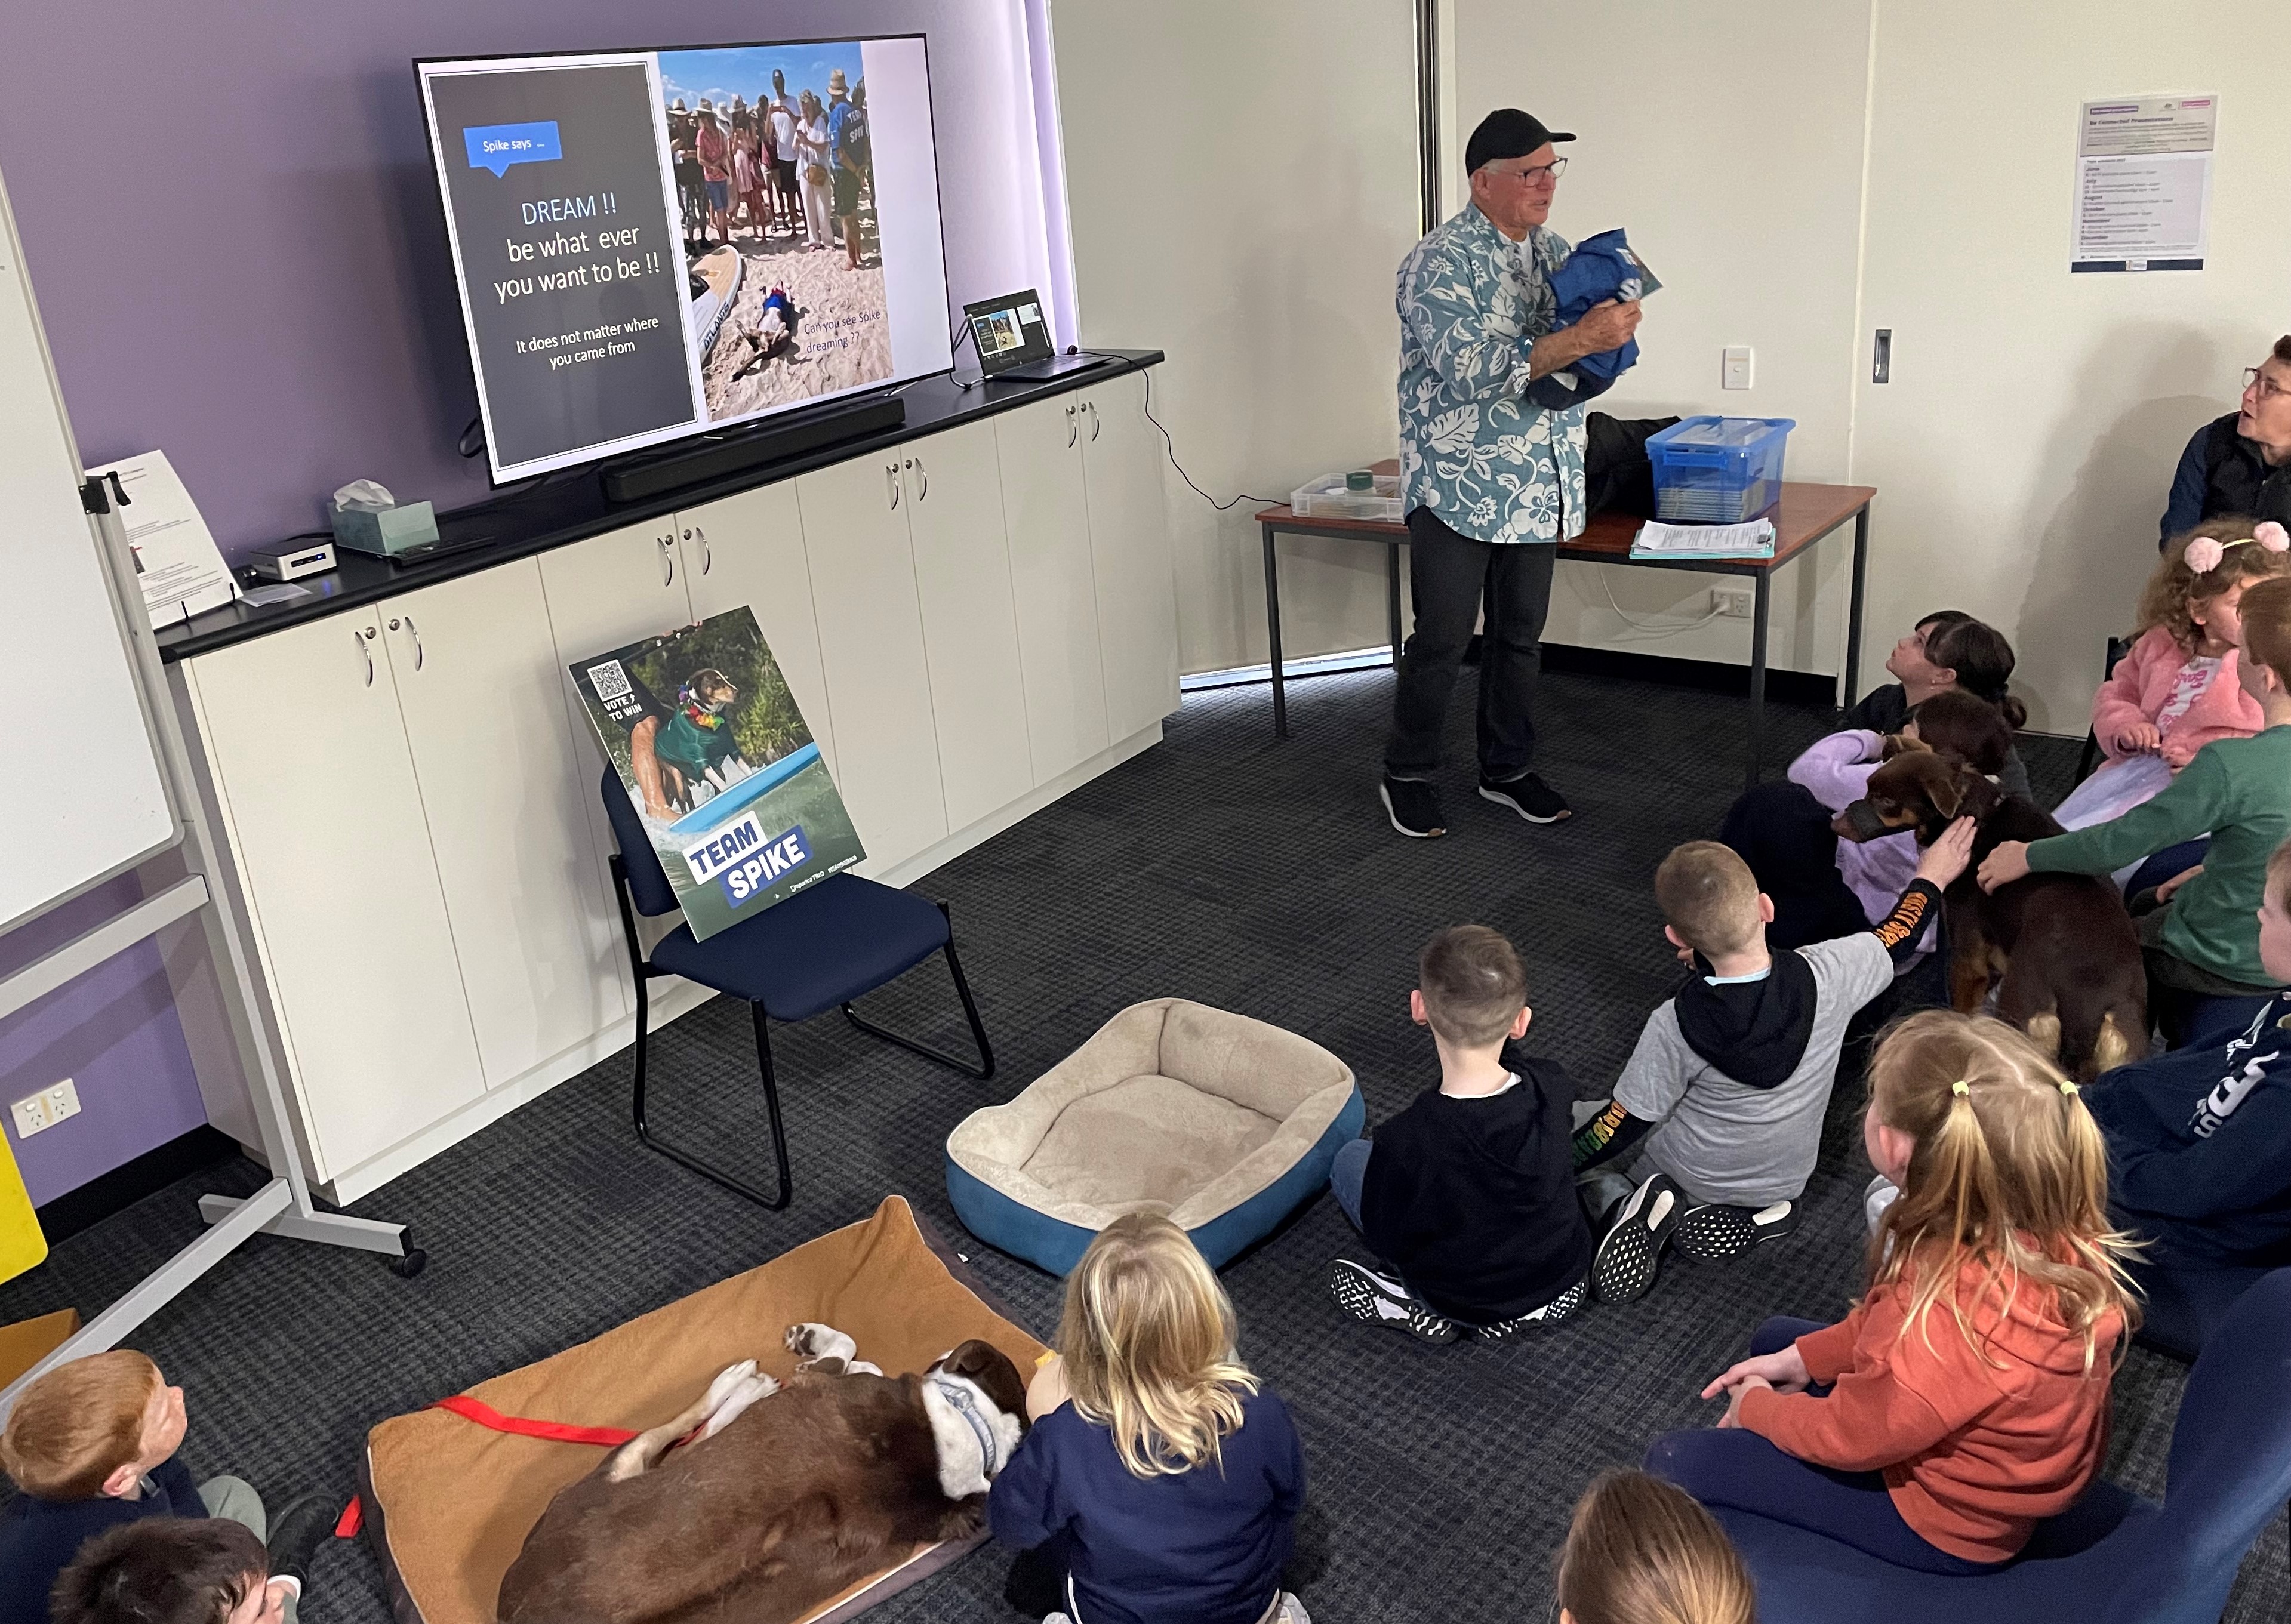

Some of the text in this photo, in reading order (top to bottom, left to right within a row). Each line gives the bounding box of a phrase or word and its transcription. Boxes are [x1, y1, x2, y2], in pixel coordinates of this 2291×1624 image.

[482, 140, 509, 153] Spike
[511, 139, 532, 151] says
[522, 192, 616, 225] DREAM !!
[507, 227, 639, 263] be what ever
[494, 252, 660, 305] you want to be !!
[516, 318, 659, 353] It does not matter where
[804, 309, 881, 335] Can you see Spike
[549, 341, 636, 371] you came from
[806, 332, 860, 353] dreaming ??
[603, 696, 629, 711] VOTE
[608, 703, 642, 722] TO WIN
[689, 820, 759, 874] TEAM
[727, 833, 805, 899] SPIKE
